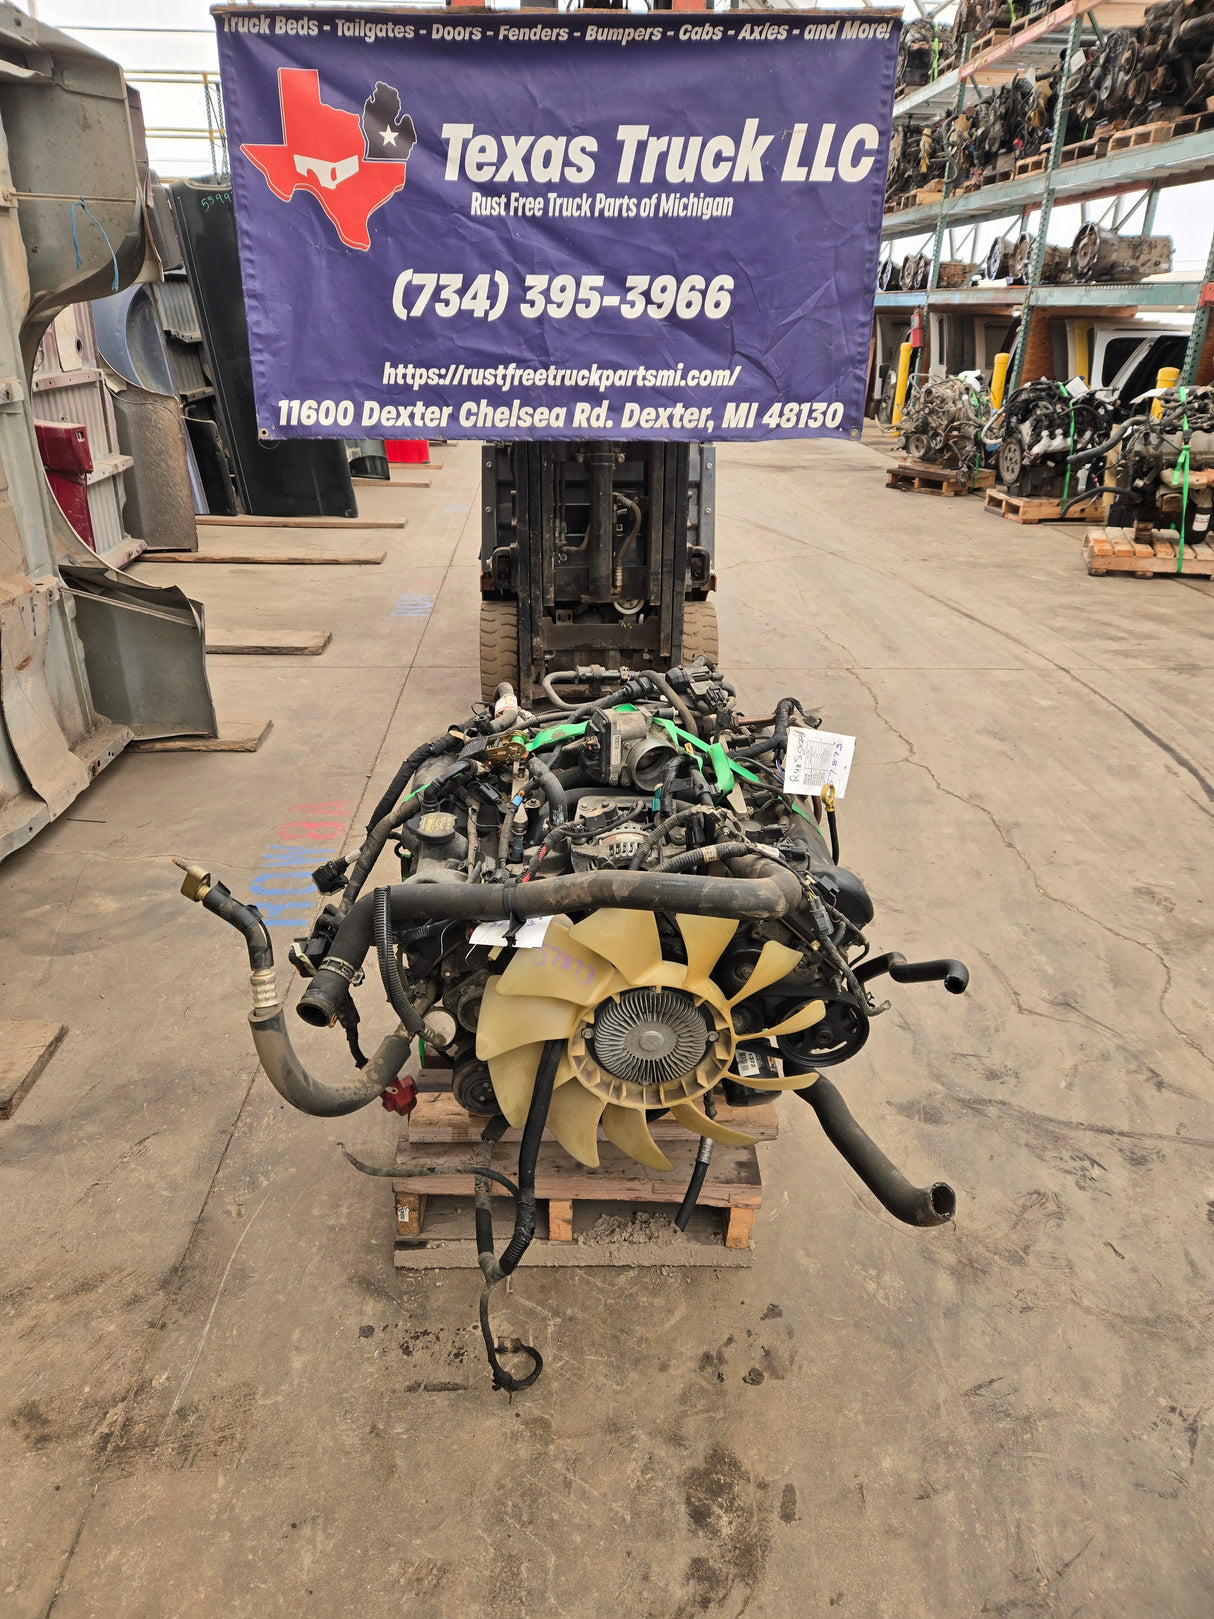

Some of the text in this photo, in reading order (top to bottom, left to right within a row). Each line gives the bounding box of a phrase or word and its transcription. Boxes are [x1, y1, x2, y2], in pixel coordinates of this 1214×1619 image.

[222, 14, 270, 35] Truck
[274, 16, 319, 36] Beds
[335, 18, 415, 43] Tailgates
[431, 23, 482, 41] Doors
[498, 25, 569, 41] Fenders
[584, 25, 663, 46] Bumpers
[678, 23, 724, 41] Cabs
[737, 22, 789, 41] Axles
[803, 20, 836, 41] and
[840, 19, 894, 40] More!
[440, 117, 880, 184] Texas Truck LLC
[200, 191, 233, 213] 5599
[470, 191, 734, 221] Rust Free Truck Parts of Michigan
[392, 268, 735, 322] (734) 395-3966
[382, 361, 742, 393] https://rustfreetruckpartsmi.com/
[277, 398, 845, 434] 11600 Dexter Chelsea Rd. Dexter, MI 48130
[533, 943, 596, 985] 57873
